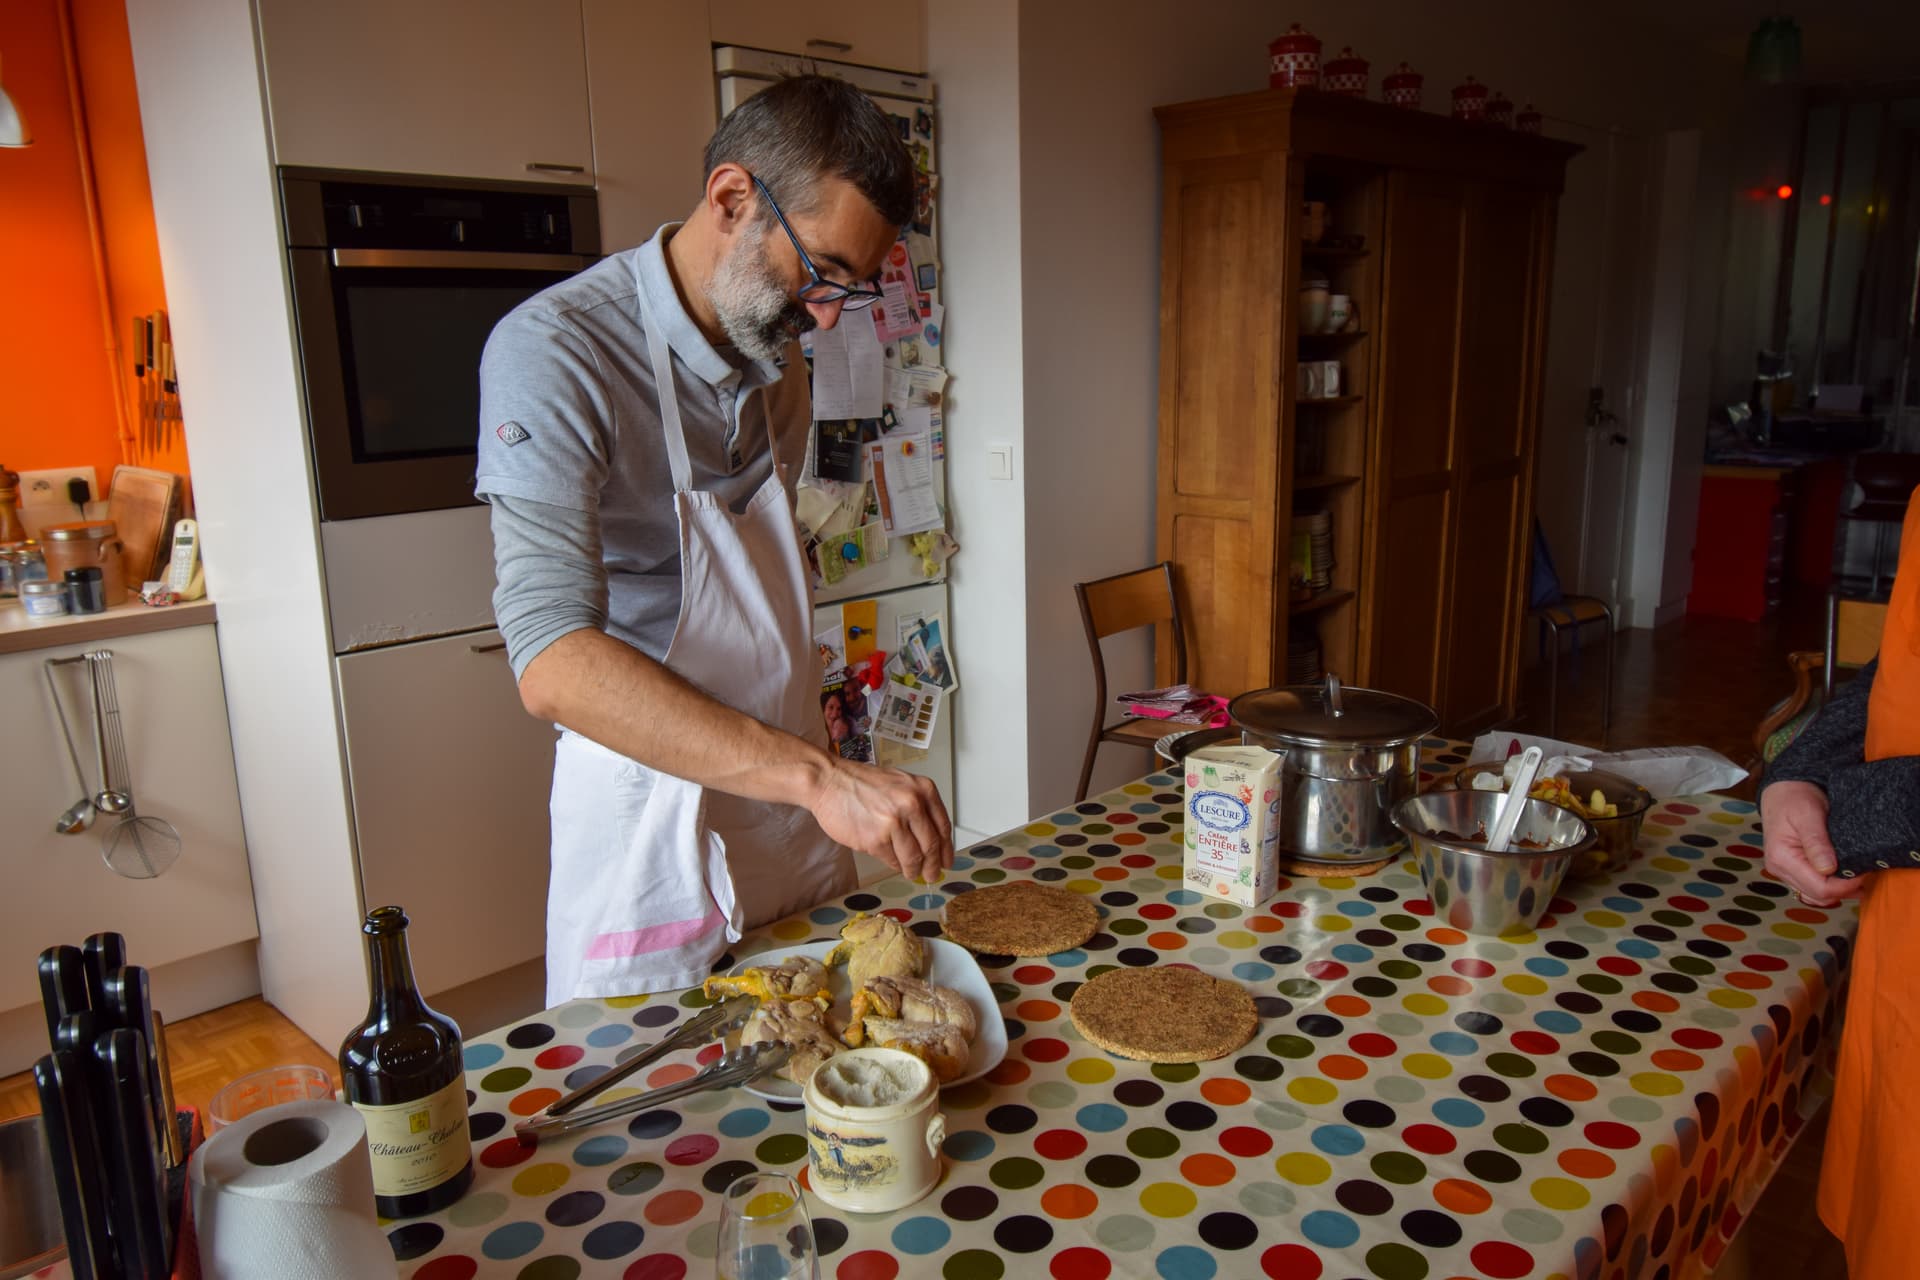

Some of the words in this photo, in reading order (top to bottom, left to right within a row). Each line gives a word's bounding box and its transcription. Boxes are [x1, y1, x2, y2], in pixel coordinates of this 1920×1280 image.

[1200, 804, 1241, 820] LESCURE
[1198, 834, 1239, 853] ENTIÈRE
[1211, 849, 1224, 861] 35
